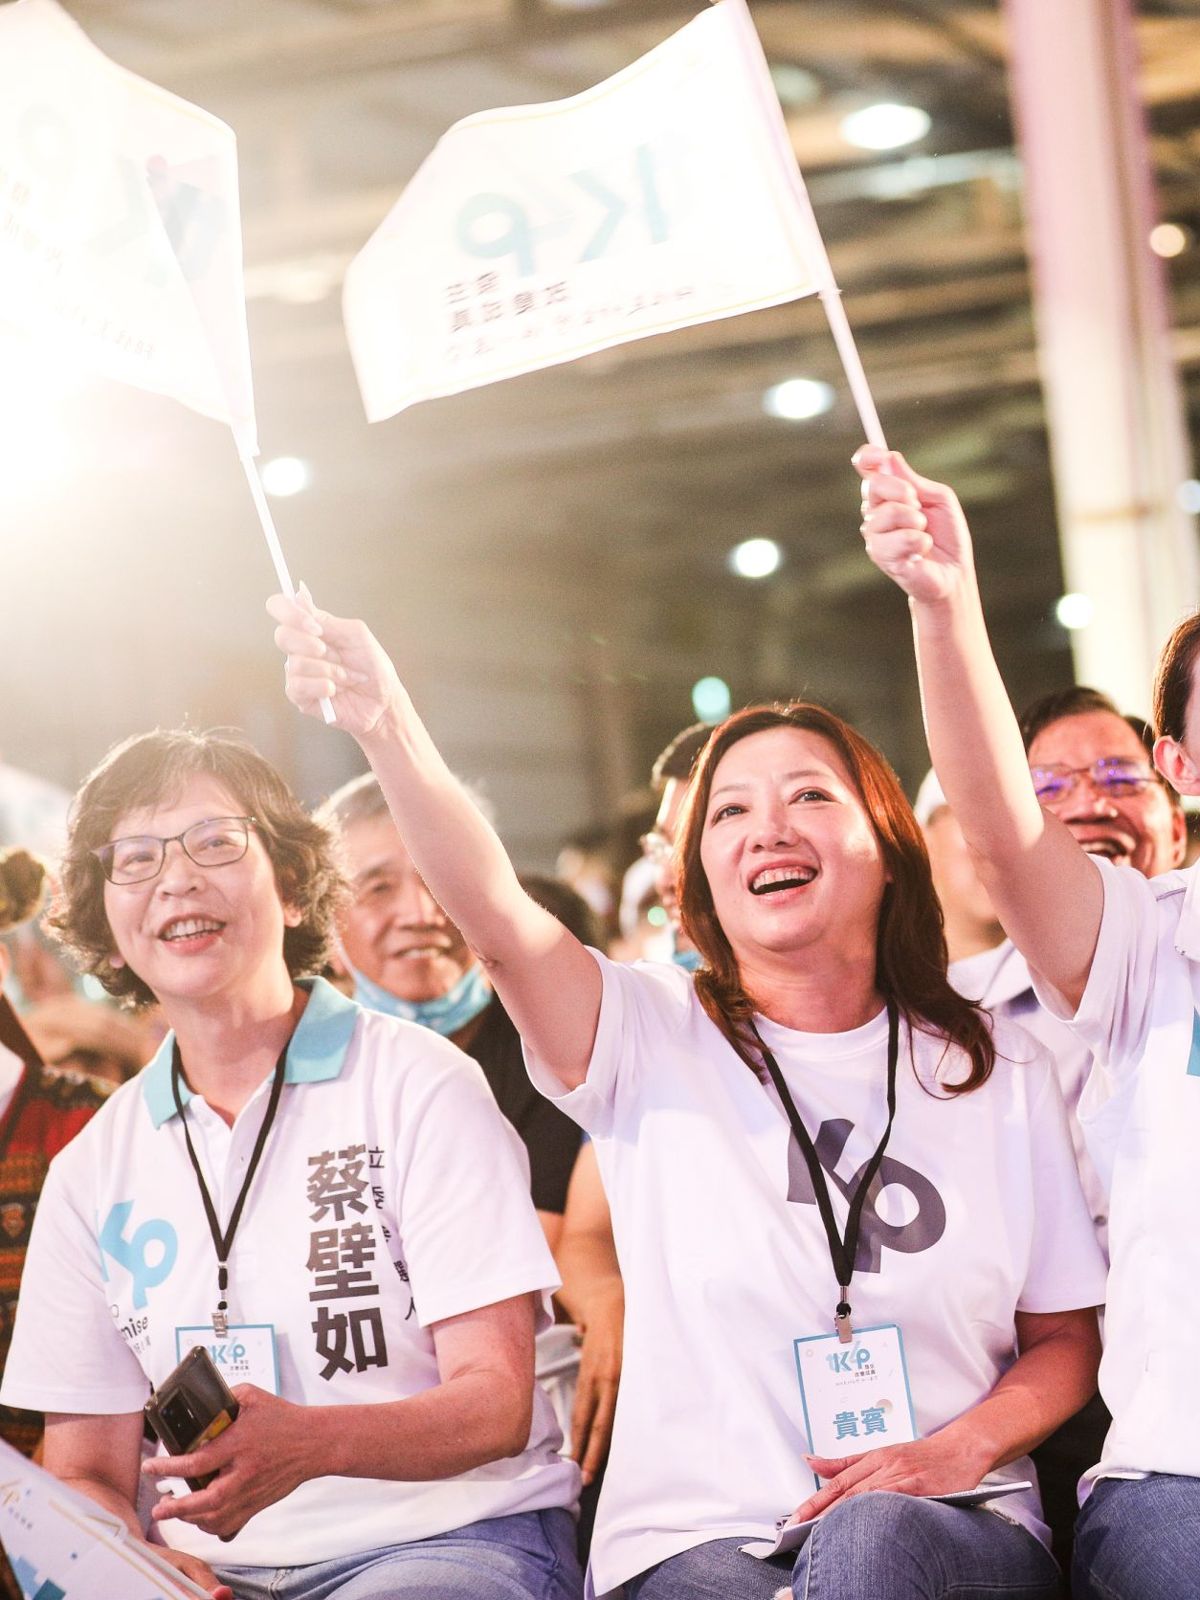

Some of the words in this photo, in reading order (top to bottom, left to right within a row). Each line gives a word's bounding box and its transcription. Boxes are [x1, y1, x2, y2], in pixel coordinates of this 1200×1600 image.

[305, 1143, 389, 1382] 蔡壁如
[832, 1406, 888, 1440] 貴賓
